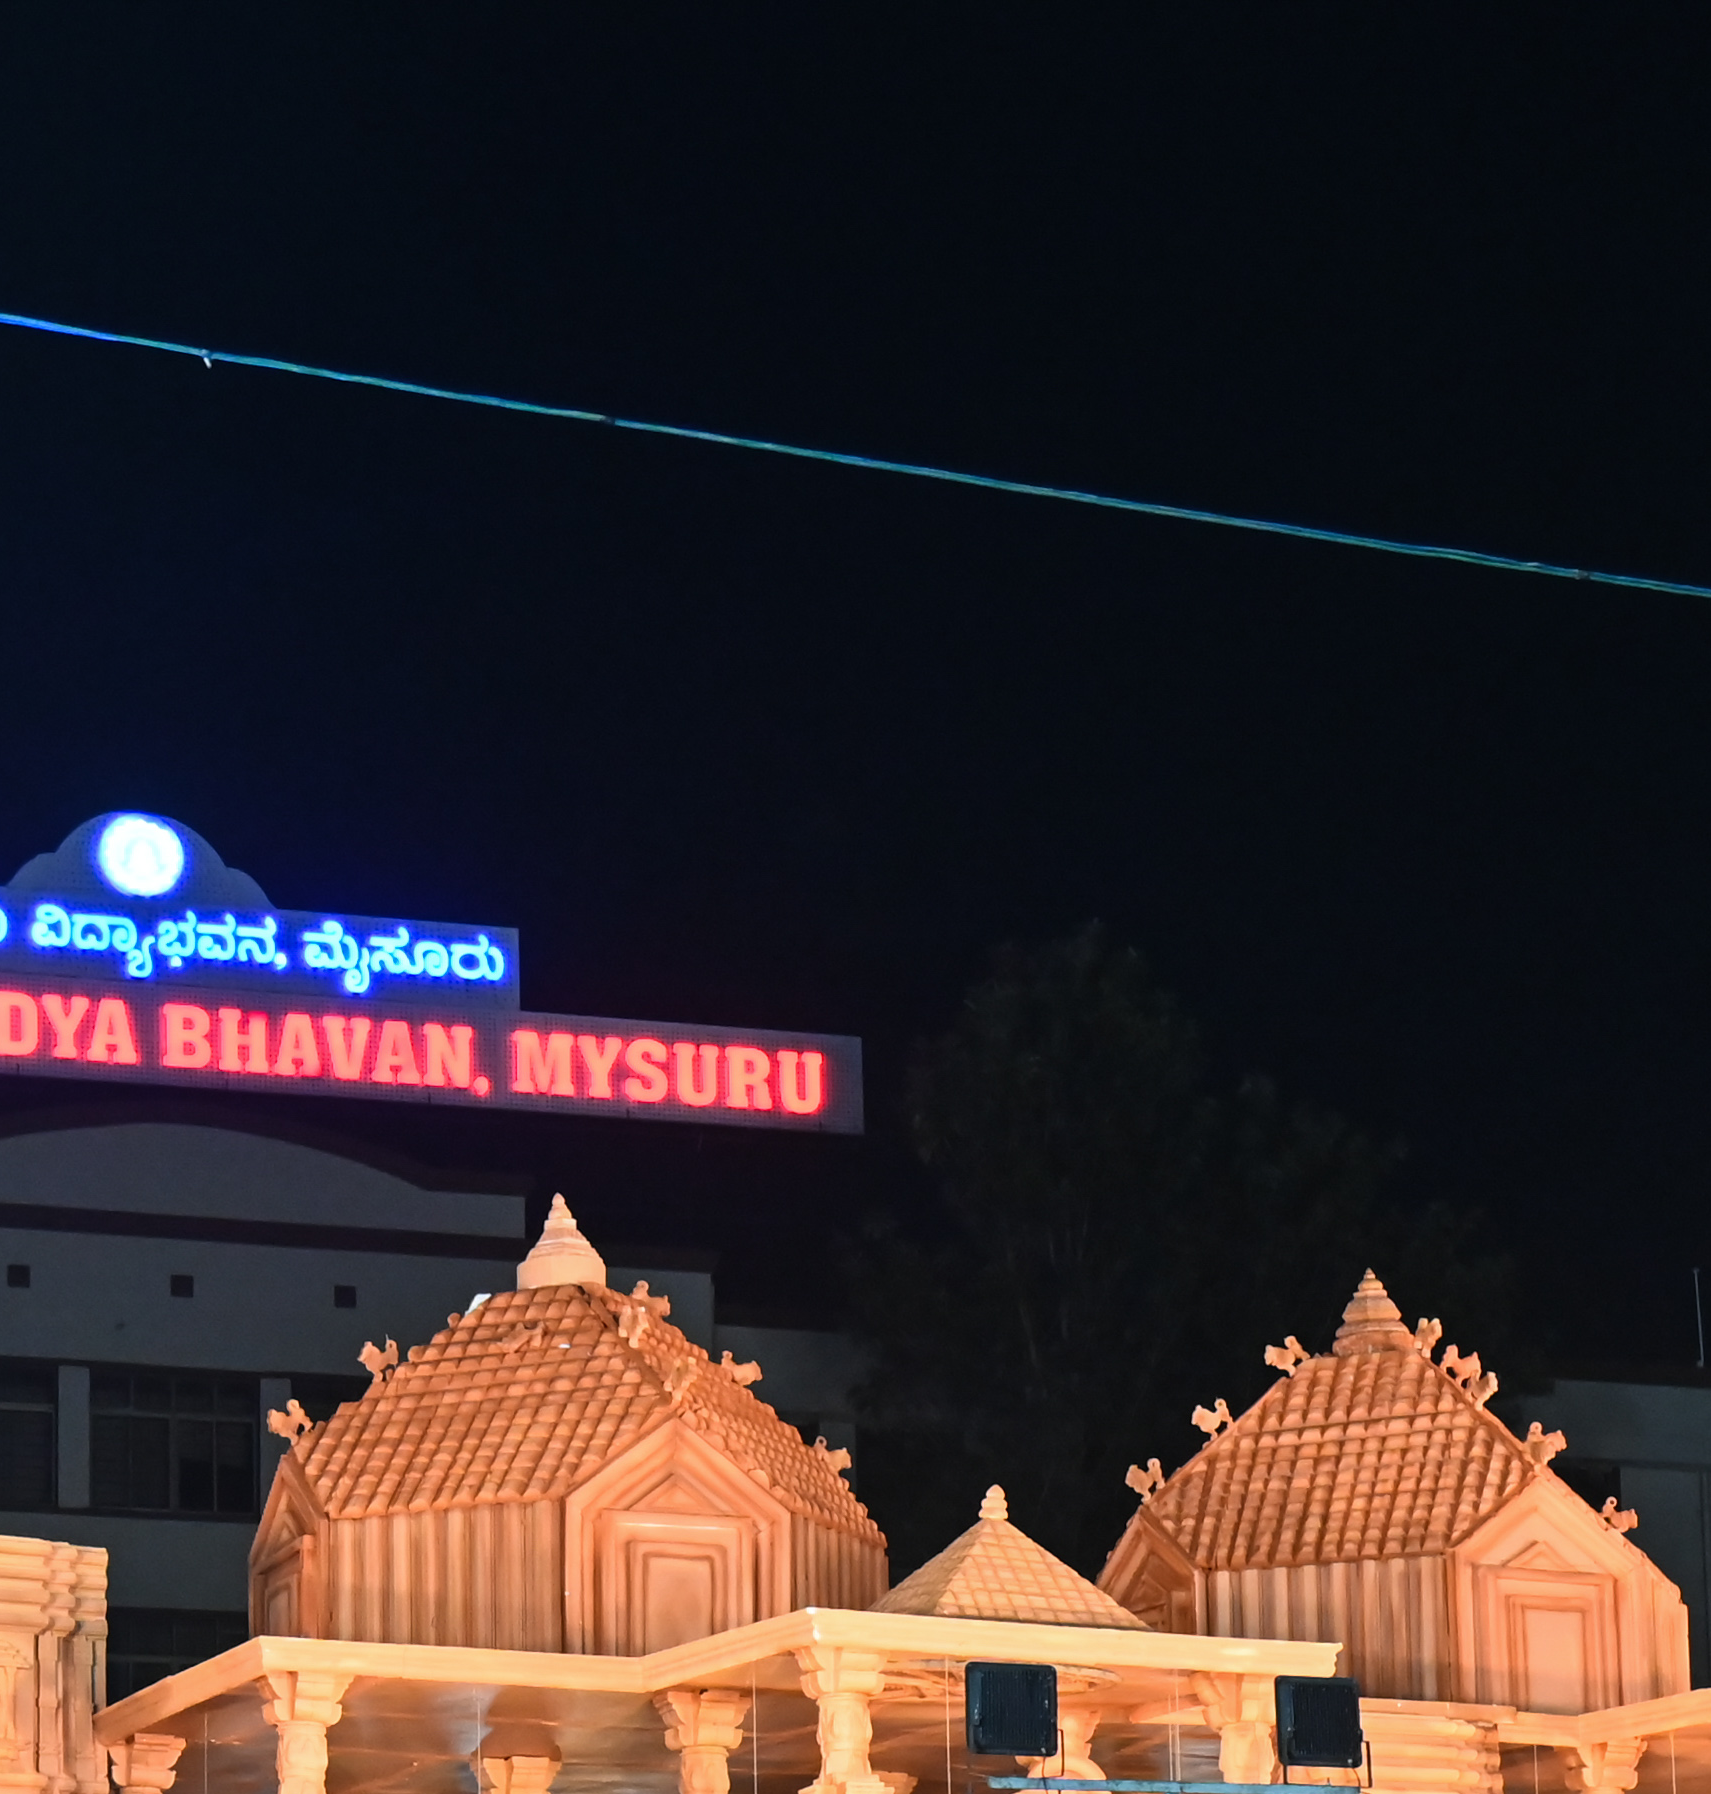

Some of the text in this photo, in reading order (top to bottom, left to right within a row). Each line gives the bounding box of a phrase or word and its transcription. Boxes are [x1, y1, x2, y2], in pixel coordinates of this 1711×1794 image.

[301, 919, 506, 995] ಮೈಸೂರು
[161, 1002, 490, 1097] BHAVAN,
[511, 1028, 824, 1114] MYSURU
